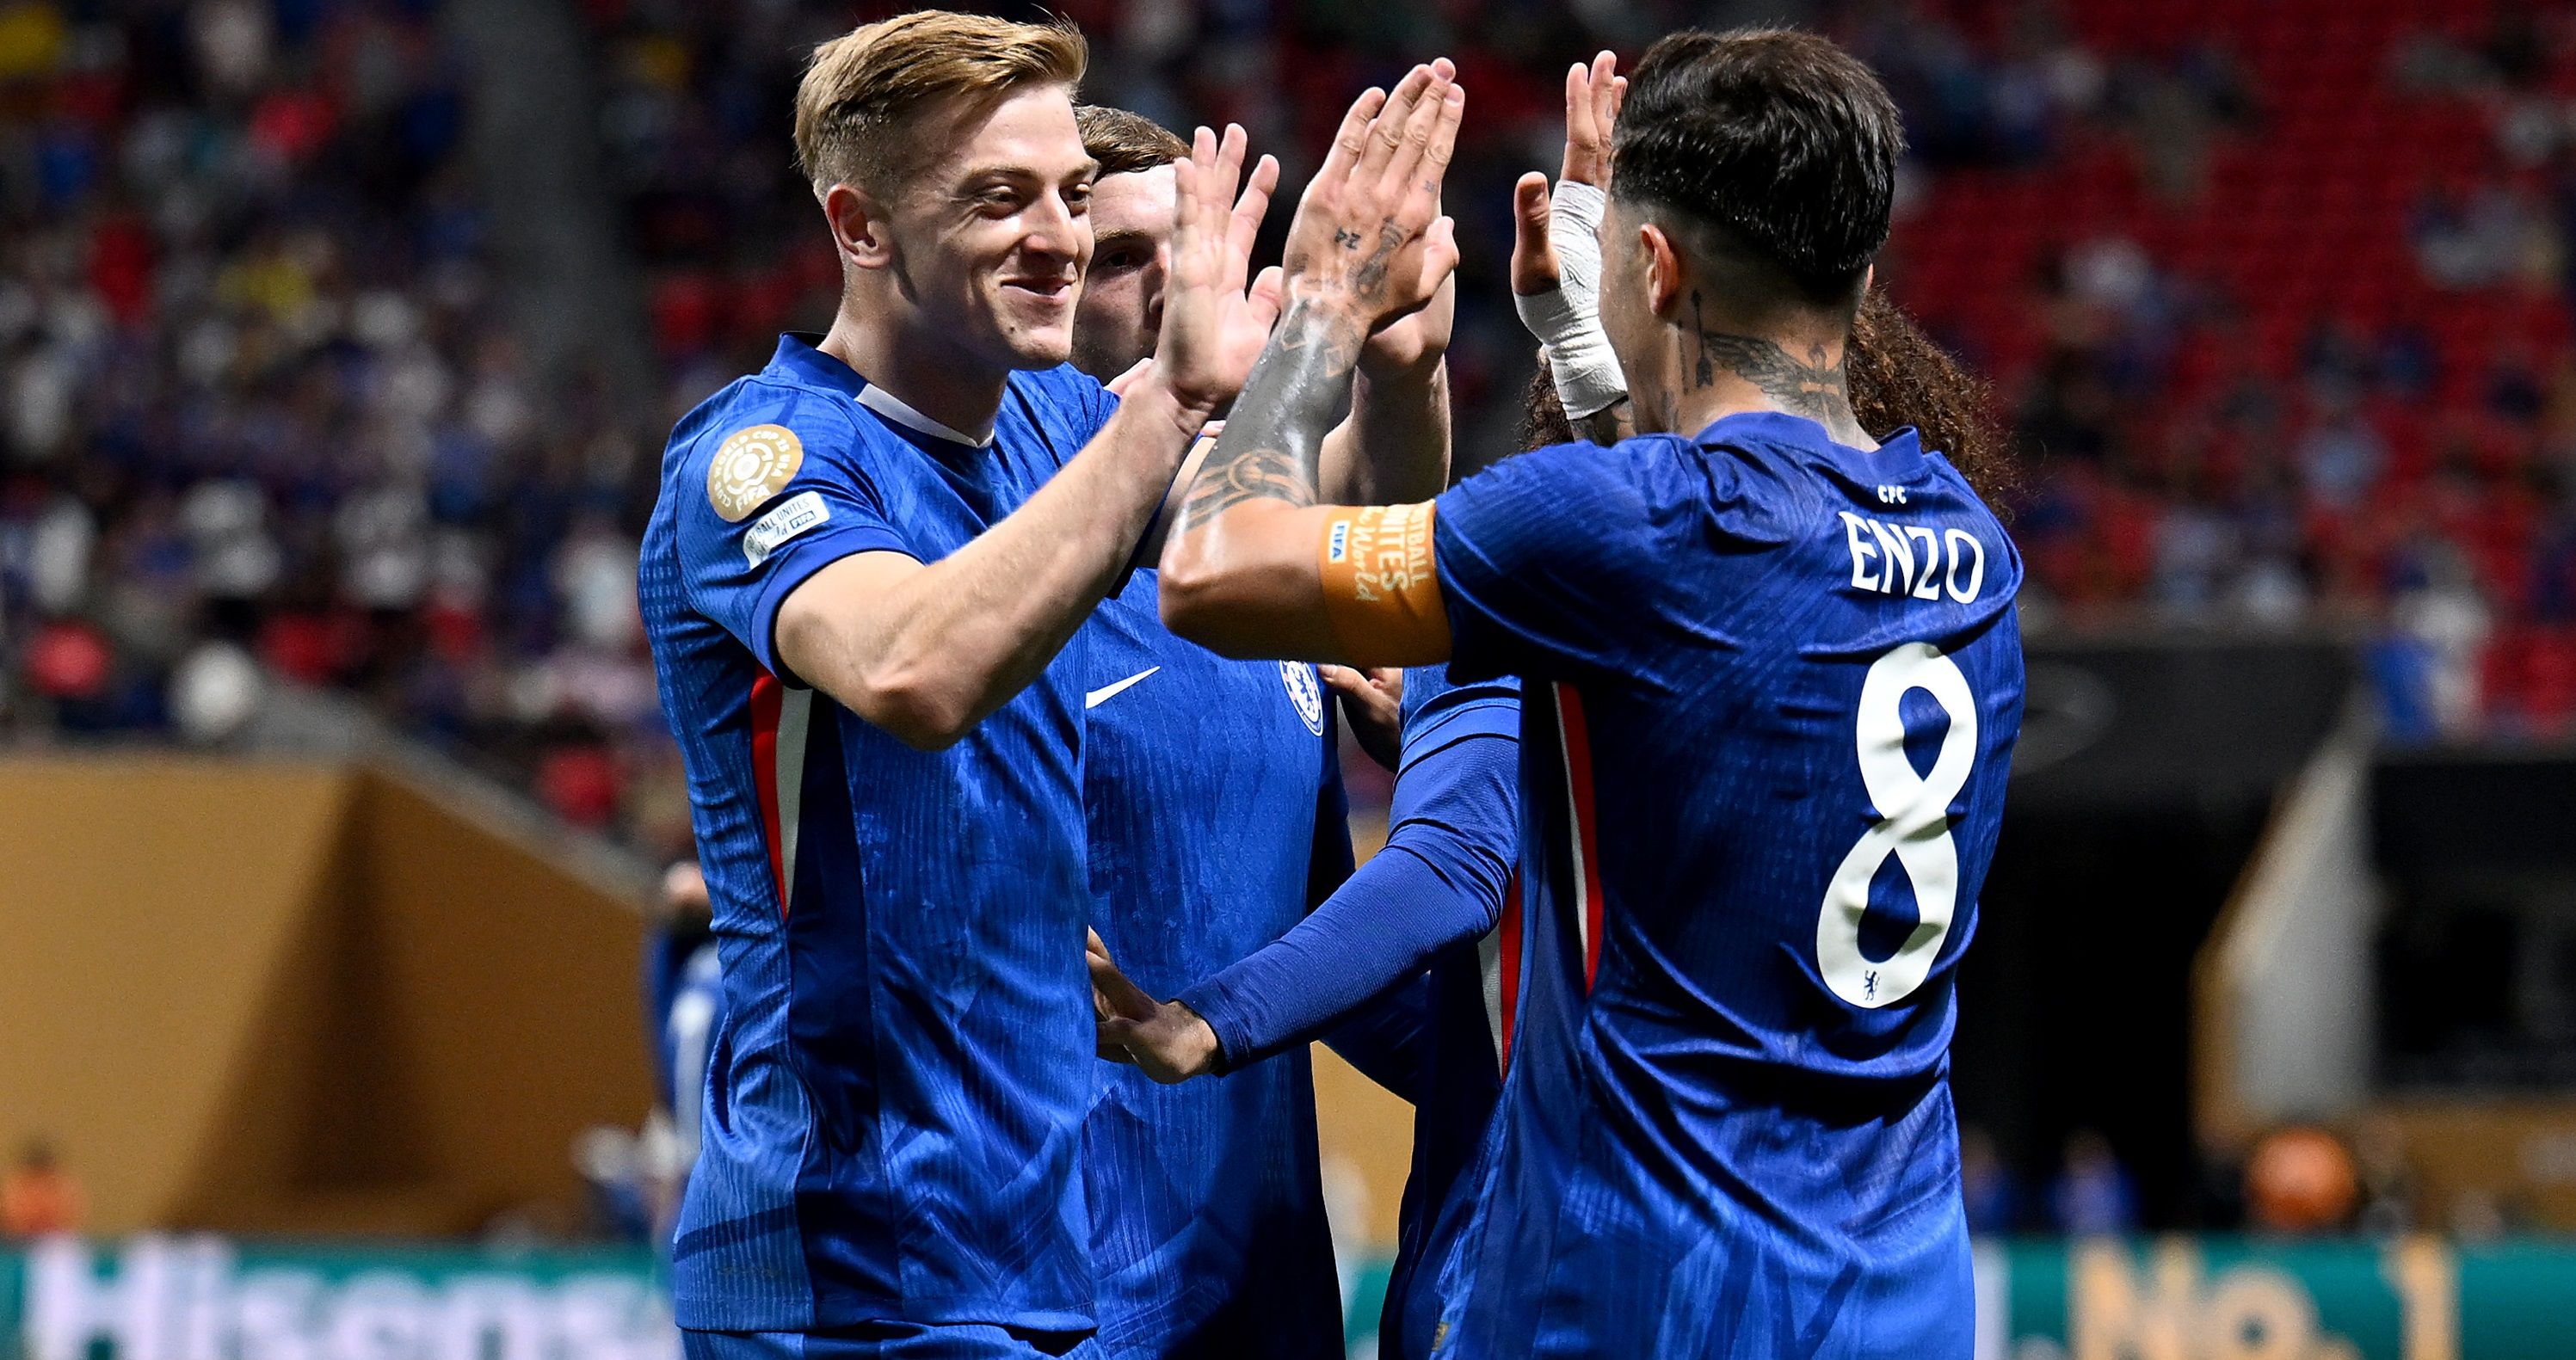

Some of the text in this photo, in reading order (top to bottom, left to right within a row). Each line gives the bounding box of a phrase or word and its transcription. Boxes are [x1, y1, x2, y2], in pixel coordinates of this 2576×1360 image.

[714, 435, 749, 478] WORLD
[752, 430, 780, 440] CUP
[736, 483, 771, 512] FIFA
[1877, 484, 1907, 504] CFC
[1332, 525, 1346, 559] FIFA
[1352, 526, 1381, 600] World
[1838, 511, 1984, 604] ENZO
[1816, 642, 1978, 1009] 8
[24, 1232, 675, 1360] Hisens
